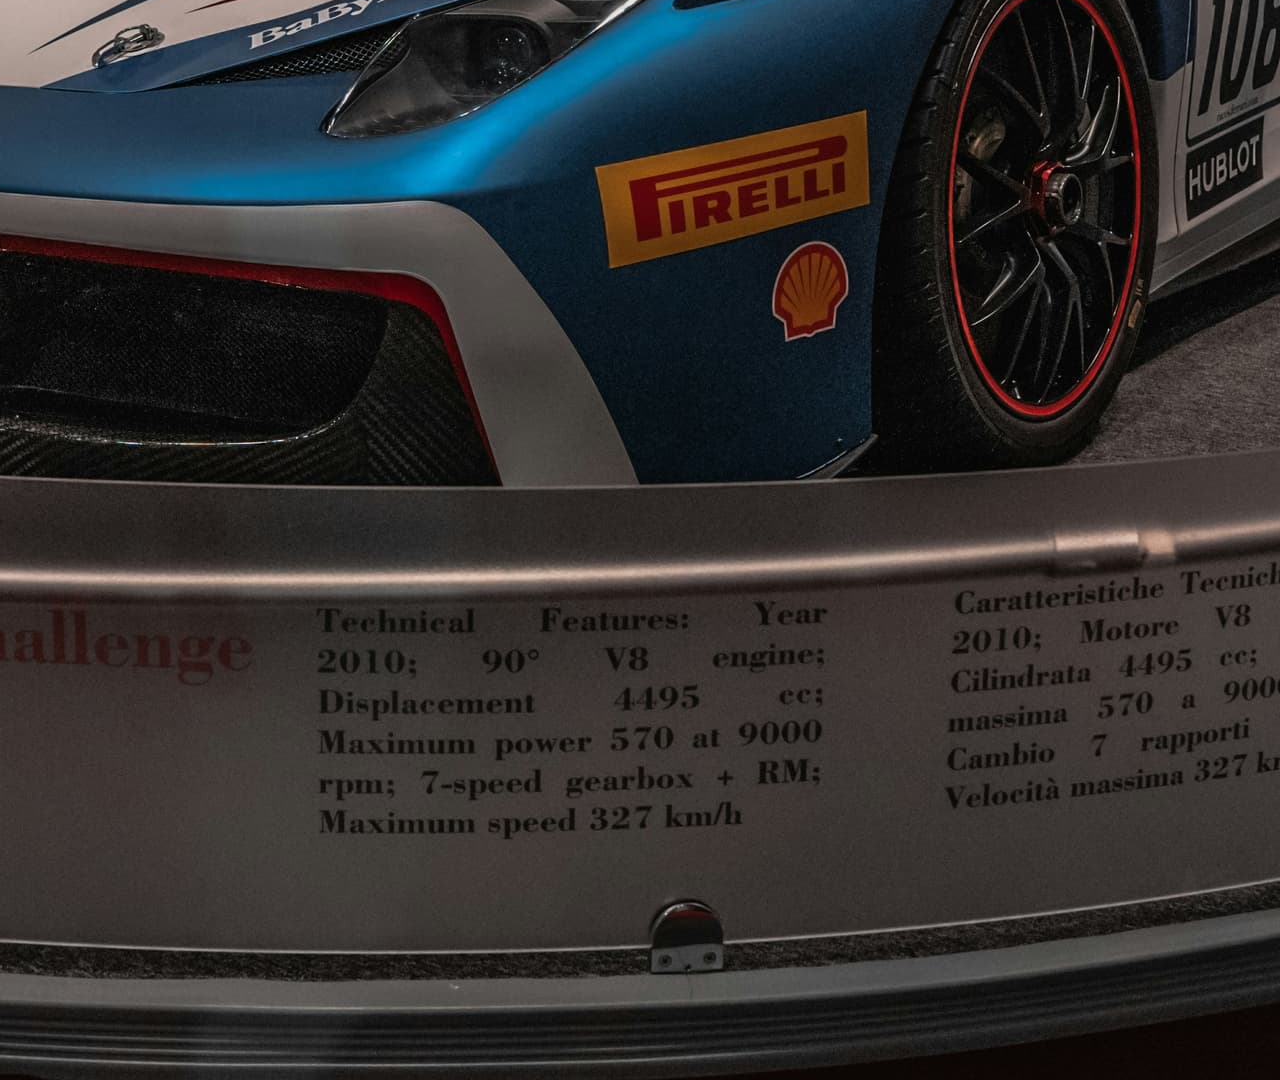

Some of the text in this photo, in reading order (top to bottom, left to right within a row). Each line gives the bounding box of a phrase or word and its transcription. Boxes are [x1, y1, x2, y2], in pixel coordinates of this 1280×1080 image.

[629, 135, 847, 242] PIRELLI
[1188, 134, 1260, 201] HUBLOT
[954, 576, 1164, 615] Caratteristiche
[316, 601, 828, 634] Technical Features: Year
[952, 626, 1041, 655] 2010;
[1080, 618, 1179, 644] Motore
[1215, 604, 1251, 628] V8
[317, 643, 824, 678] 2010; 90° V8 engine;
[950, 664, 1091, 694] Cilindrata
[1119, 648, 1192, 677] 4495
[1220, 649, 1257, 667] cc;
[319, 684, 823, 722] Displacement 4495 cc;
[948, 705, 1068, 733] massima
[1098, 691, 1154, 719] 570
[1181, 694, 1196, 710] a
[318, 719, 822, 758] Maximum power 570 at 9000
[946, 742, 1055, 771] Cambio
[1091, 733, 1108, 757] 7
[1141, 717, 1250, 752] rapporti
[319, 758, 820, 801] rpm; 7-speed gearbox + RM;
[945, 777, 1060, 809] Velocità
[1070, 768, 1184, 798] massima
[1194, 753, 1248, 782] 327
[320, 801, 742, 839] Maximum speed 327 km/h
